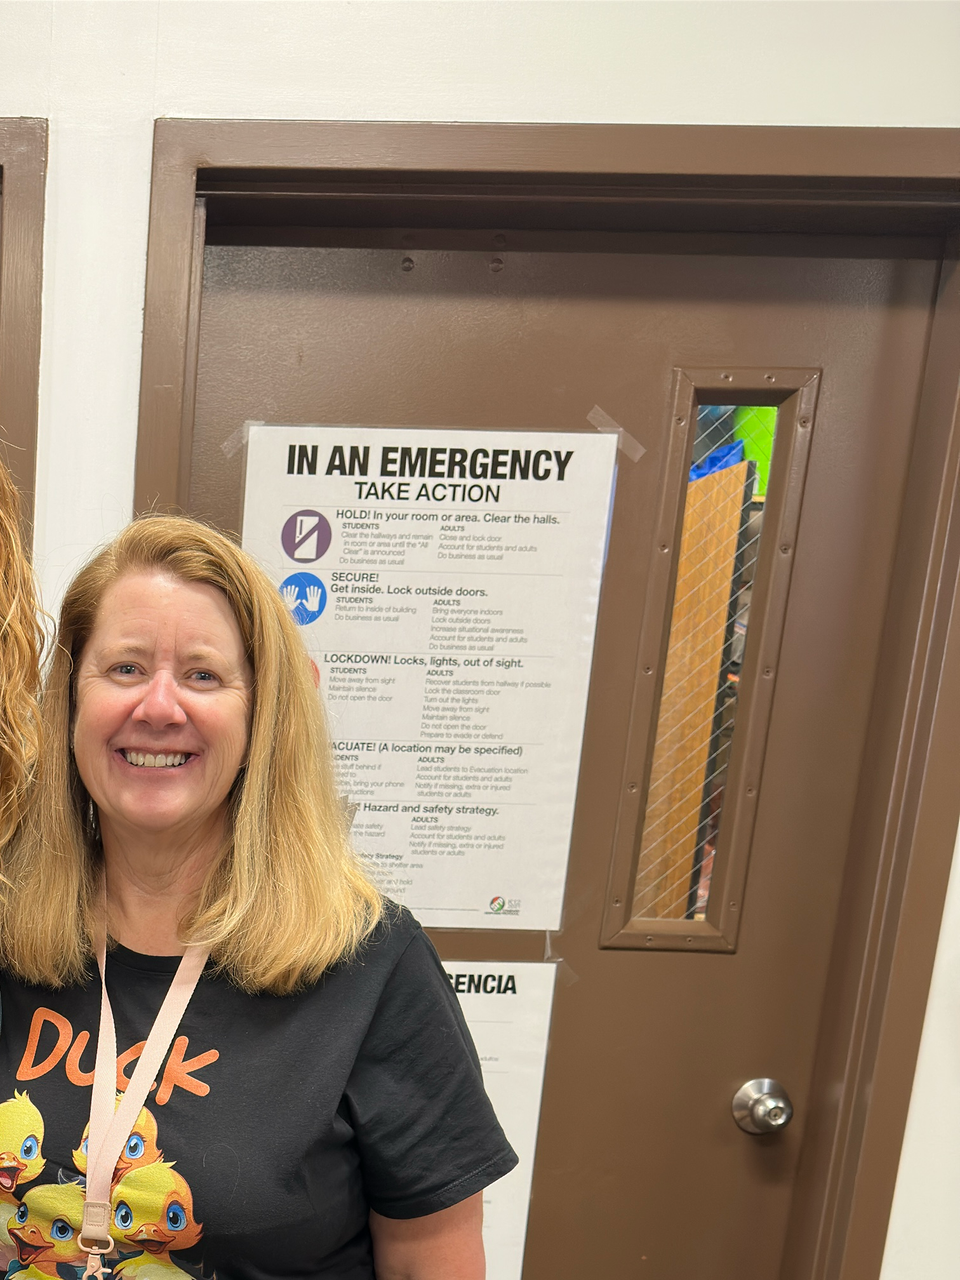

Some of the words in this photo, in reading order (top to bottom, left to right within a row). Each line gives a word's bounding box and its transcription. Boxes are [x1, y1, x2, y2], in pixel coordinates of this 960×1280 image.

[287, 444, 318, 476] IN
[326, 446, 370, 476] AN
[380, 447, 574, 482] EMERGENCY
[354, 482, 410, 500] TAKE
[416, 484, 500, 503] ACTION
[336, 510, 371, 519] HOLD!
[373, 510, 383, 519] In
[386, 513, 408, 522] your
[484, 513, 510, 523] Clear
[514, 514, 530, 523] the
[533, 515, 560, 524] halls.
[331, 573, 379, 582] SECURE!
[330, 584, 349, 593] Get
[351, 584, 385, 594] inside.
[387, 585, 413, 594] Lock
[415, 586, 453, 596] outside
[456, 587, 488, 596] doors.
[324, 654, 392, 664] LOCKDOWN!
[394, 655, 428, 666] Locks,
[430, 656, 462, 668] lights,
[464, 657, 480, 666] out
[483, 658, 494, 666] of
[496, 658, 524, 670] sight.
[378, 743, 389, 754] (A
[392, 743, 432, 753] location
[434, 746, 456, 756] may
[458, 745, 472, 754] be
[474, 745, 522, 757] specified)
[363, 802, 399, 812] Hazard
[402, 804, 421, 813] and
[423, 804, 454, 816] safety
[456, 805, 499, 817] strategy.
